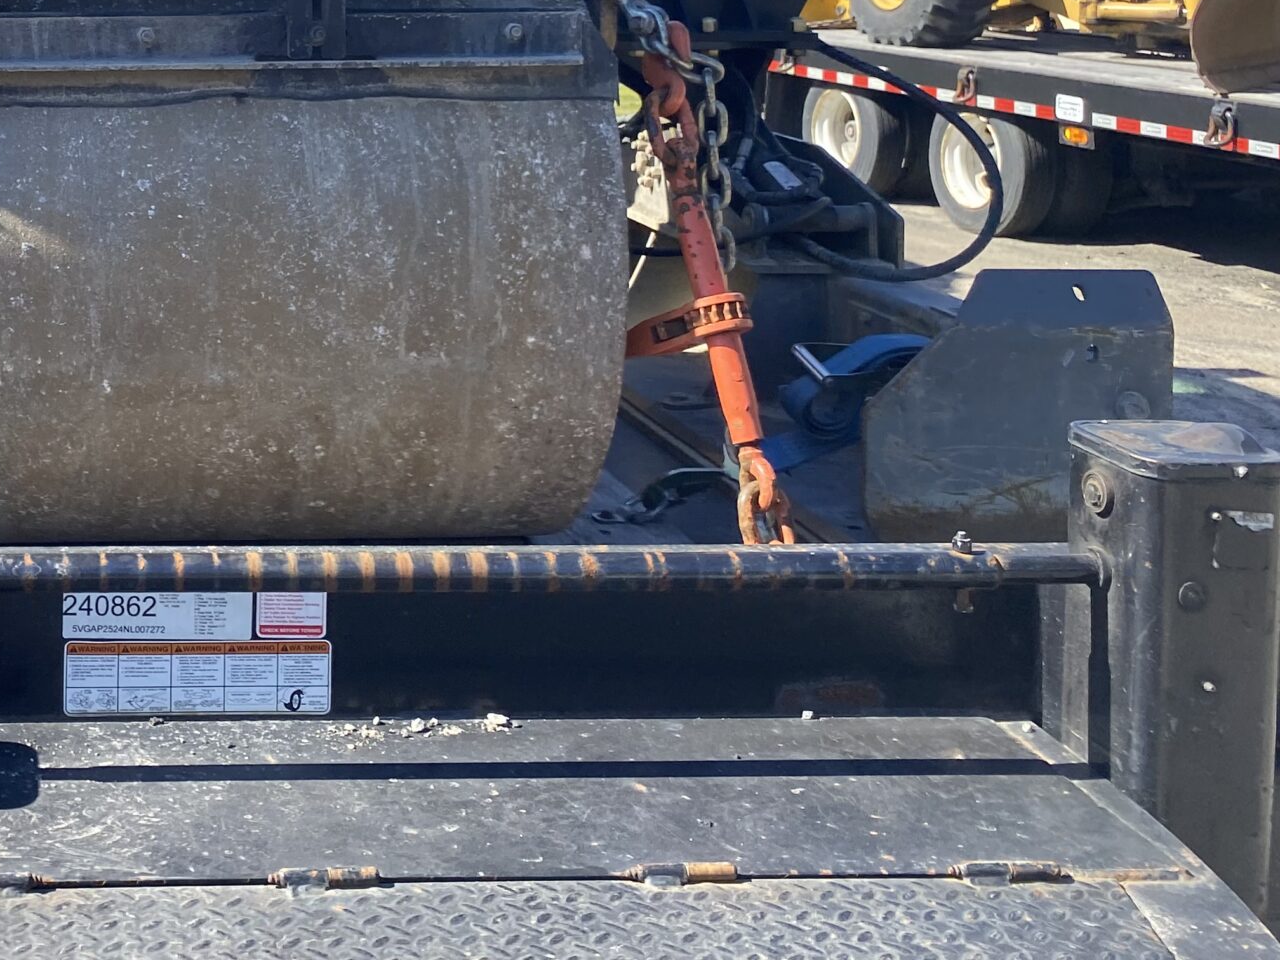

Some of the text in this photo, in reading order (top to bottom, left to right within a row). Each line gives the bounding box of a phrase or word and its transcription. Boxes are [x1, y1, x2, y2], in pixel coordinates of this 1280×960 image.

[63, 594, 157, 617] 240862
[72, 624, 166, 634] 5VGAP2524NL007272
[236, 644, 276, 652] WARNING
